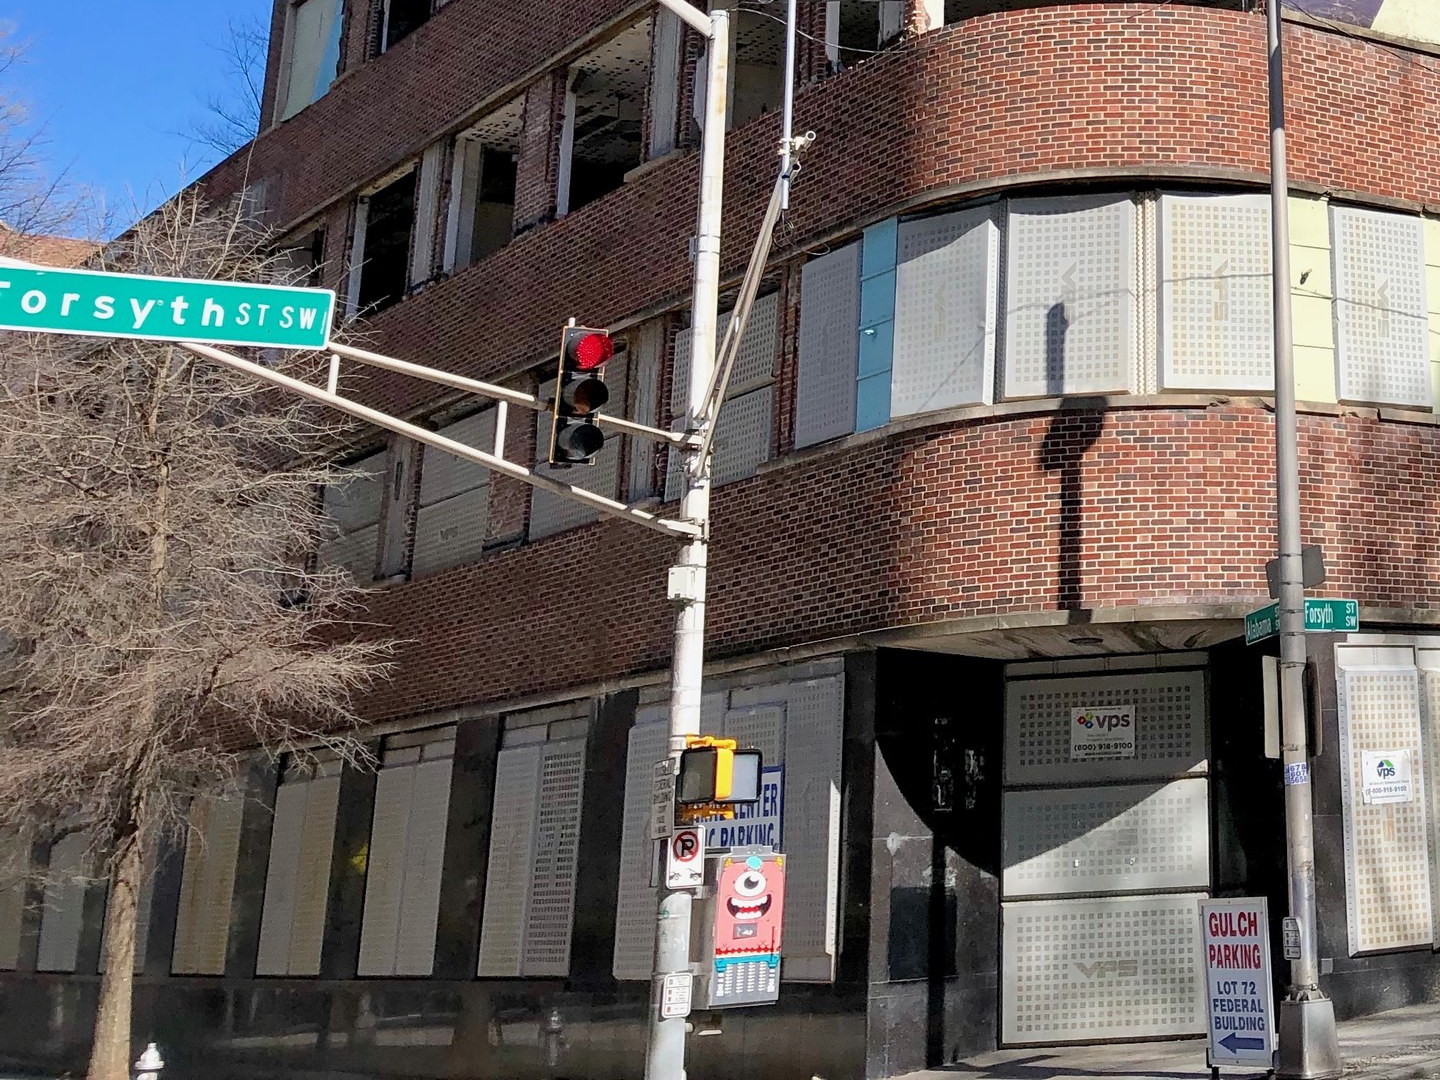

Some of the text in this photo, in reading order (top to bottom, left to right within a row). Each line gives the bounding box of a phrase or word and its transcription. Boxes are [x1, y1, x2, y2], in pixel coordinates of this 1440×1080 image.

[235, 302, 271, 327] ST
[279, 305, 317, 331] SW
[1305, 602, 1355, 628] Forsyth ST
[1346, 616, 1356, 627] SW
[1094, 713, 1131, 732] vps
[1376, 767, 1396, 780] vps
[720, 822, 775, 848] PARKING
[1208, 911, 1258, 937] GULCH
[1208, 943, 1262, 970] PARKING
[1073, 959, 1138, 980] VPS
[1216, 981, 1257, 995] LOT 72
[1213, 998, 1264, 1014] FEDERAL
[1214, 1015, 1265, 1031] BUILDING
